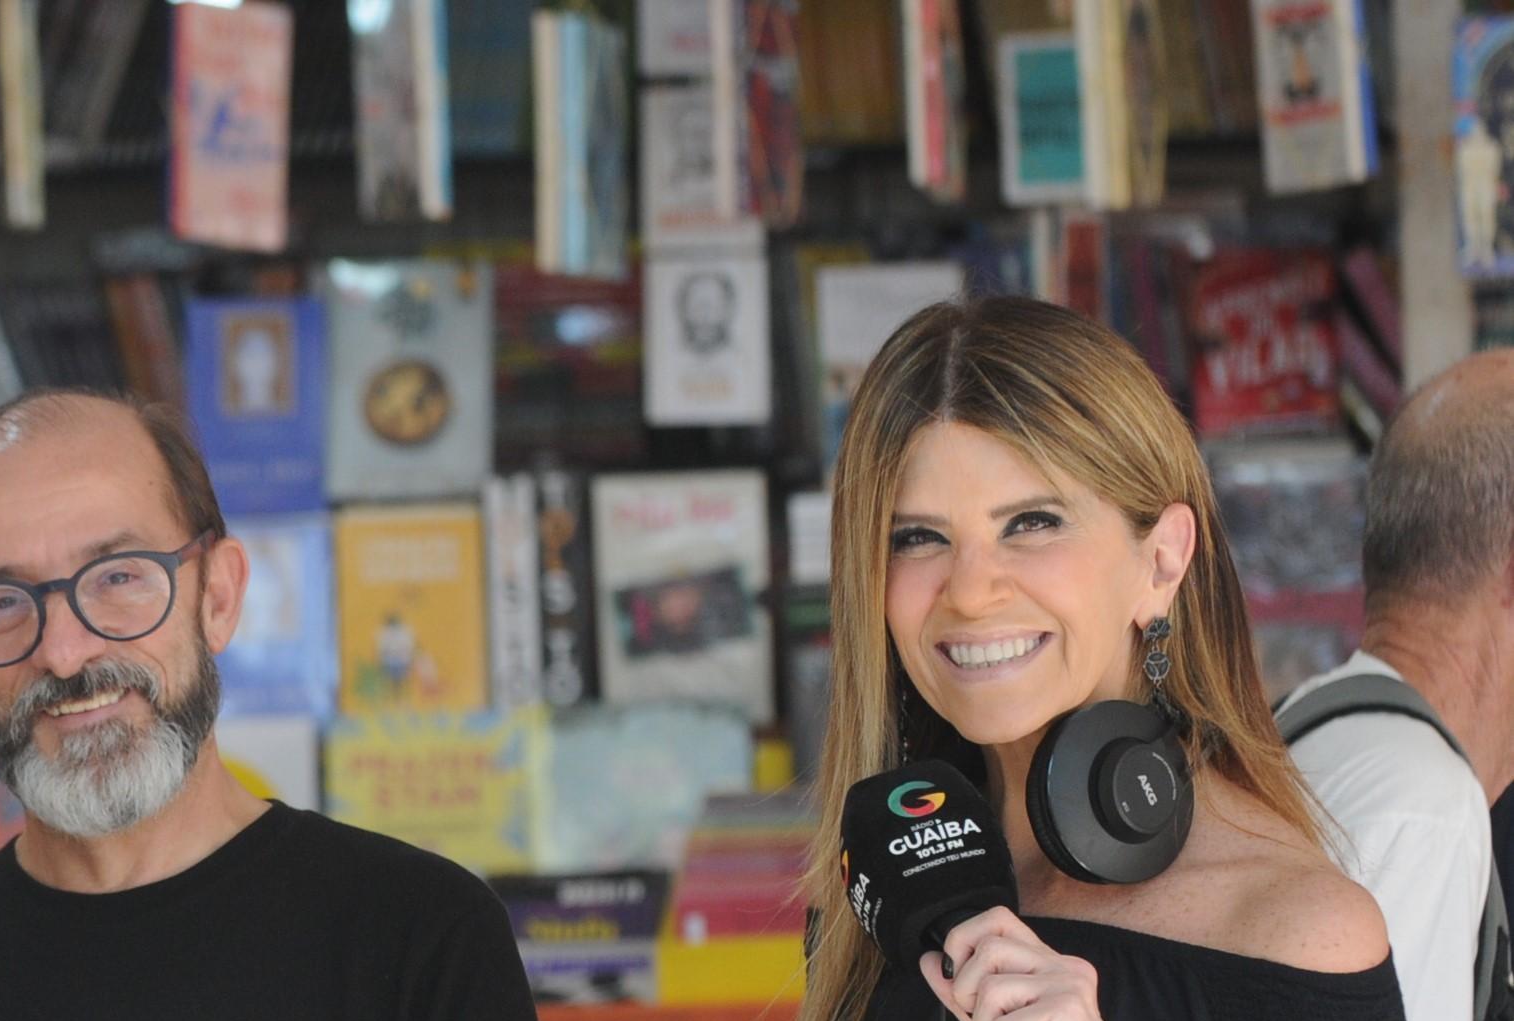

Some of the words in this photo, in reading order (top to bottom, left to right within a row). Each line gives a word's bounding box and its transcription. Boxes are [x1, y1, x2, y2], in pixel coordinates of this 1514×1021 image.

[1137, 774, 1158, 807] AKG
[888, 818, 982, 855] GUAÍBA
[910, 819, 934, 832] RÁDIO
[902, 858, 947, 877] CONECTANDO
[946, 854, 960, 862] TEU
[960, 848, 986, 858] MUNDO
[915, 843, 946, 859] 101.3
[946, 838, 964, 850] FM
